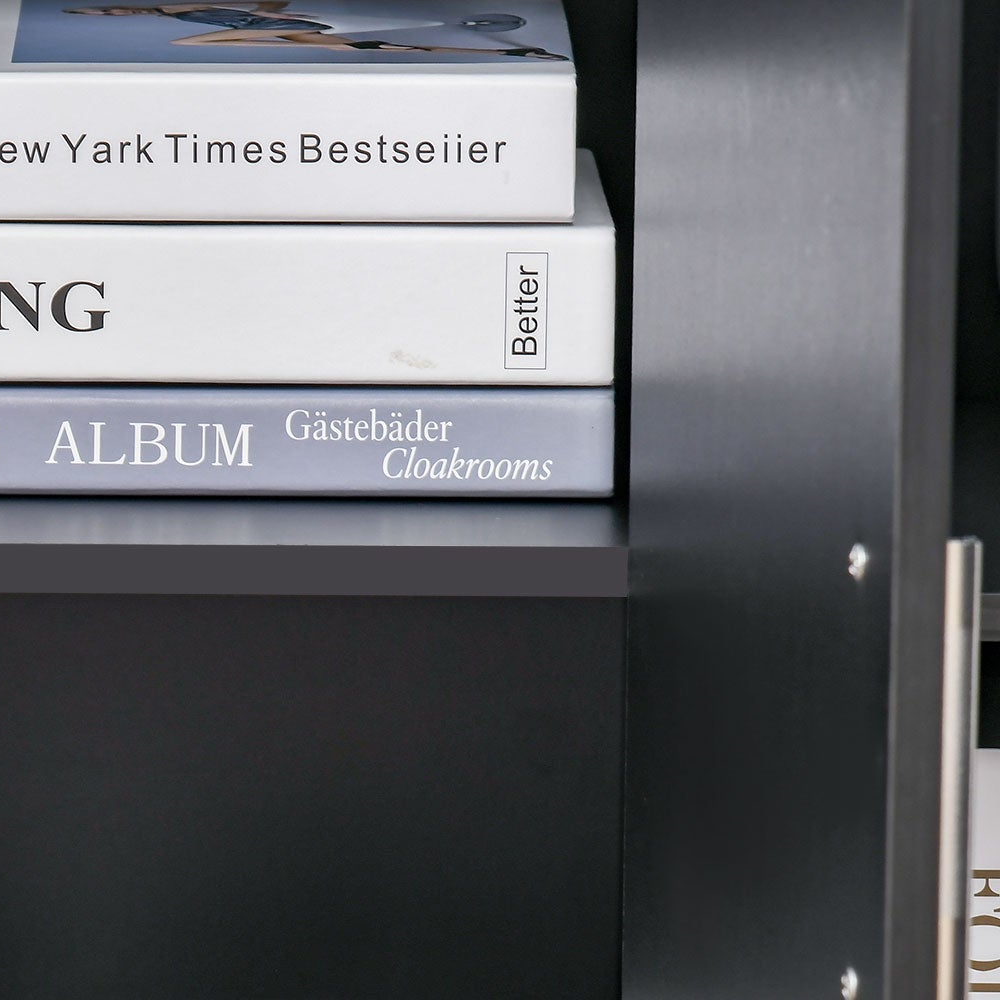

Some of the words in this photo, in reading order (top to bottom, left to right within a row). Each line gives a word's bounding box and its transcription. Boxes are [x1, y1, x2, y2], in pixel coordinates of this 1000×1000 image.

[61, 134, 154, 164] Yark
[165, 134, 287, 164] Times
[299, 134, 507, 164] Bestseiier
[511, 265, 539, 357] Better
[284, 408, 454, 443] Gästebäder
[45, 420, 254, 467] ALBUM
[381, 447, 554, 482] Cloakrooms
